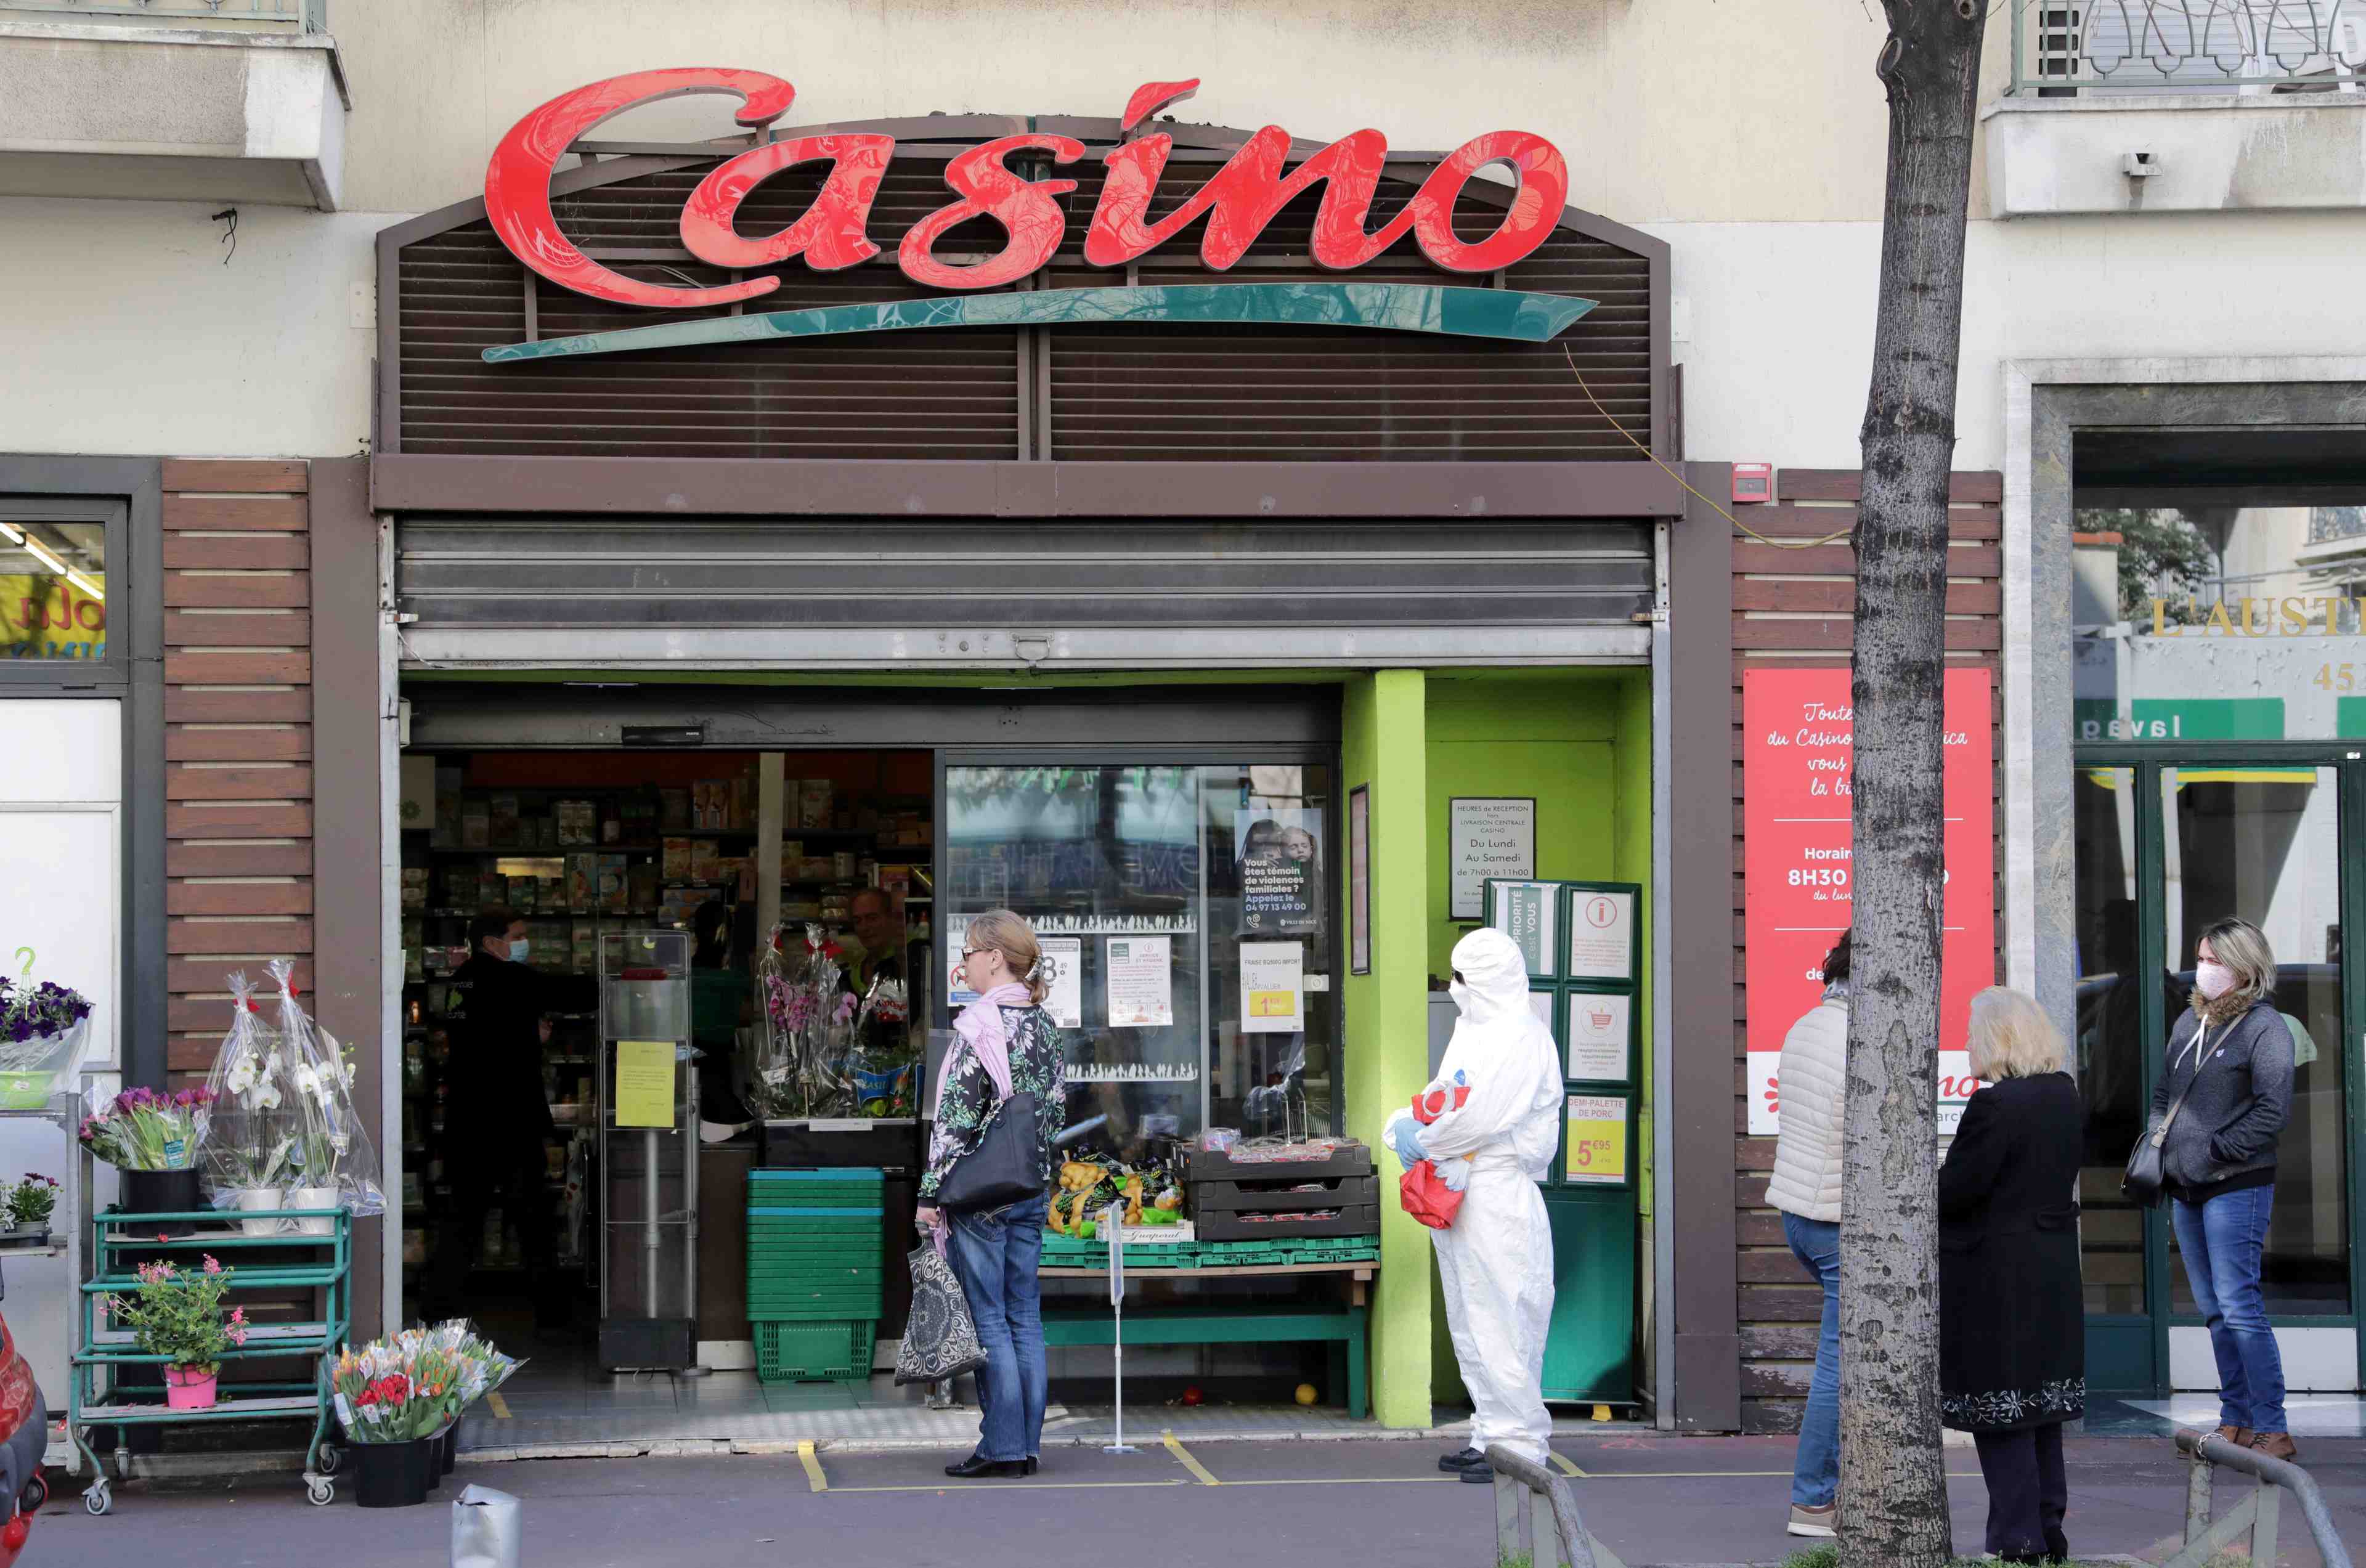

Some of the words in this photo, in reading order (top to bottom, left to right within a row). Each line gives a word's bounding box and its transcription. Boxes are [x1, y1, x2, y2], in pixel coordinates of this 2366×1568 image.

[484, 67, 1568, 308] Casino
[2312, 662, 2356, 691] 45
[1767, 730, 1789, 746] du
[1796, 728, 1853, 747] Casino
[1807, 757, 1847, 771] vous
[1811, 777, 1828, 796] la
[1470, 839, 1485, 848] Du
[1488, 838, 1516, 848] Lundi
[1465, 853, 1479, 863] Au
[1483, 853, 1521, 863] Samedi
[1804, 847, 1853, 859] Horair
[1245, 859, 1267, 867] Vous
[1245, 867, 1266, 875] êtes
[1267, 866, 1300, 875] témoin
[1457, 868, 1468, 876] de
[1470, 868, 1492, 876] 7h00
[1503, 868, 1529, 876] 11h00
[1245, 876, 1258, 885] de
[1258, 875, 1304, 884] violences
[1788, 869, 1847, 886] 8H30
[1245, 885, 1292, 893] familiales
[1813, 889, 1829, 900] du
[1832, 887, 1853, 901] lun
[1245, 894, 1284, 904] Appelez
[1294, 903, 1307, 911] 00
[1511, 890, 1522, 943] PRIORITÉ
[1527, 902, 1537, 933] VOUS
[1567, 1098, 1625, 1108] DEMI-PALETTE
[1579, 1108, 1590, 1117] DE
[1592, 1110, 1613, 1118] PORC
[1577, 1140, 1592, 1167] 5
